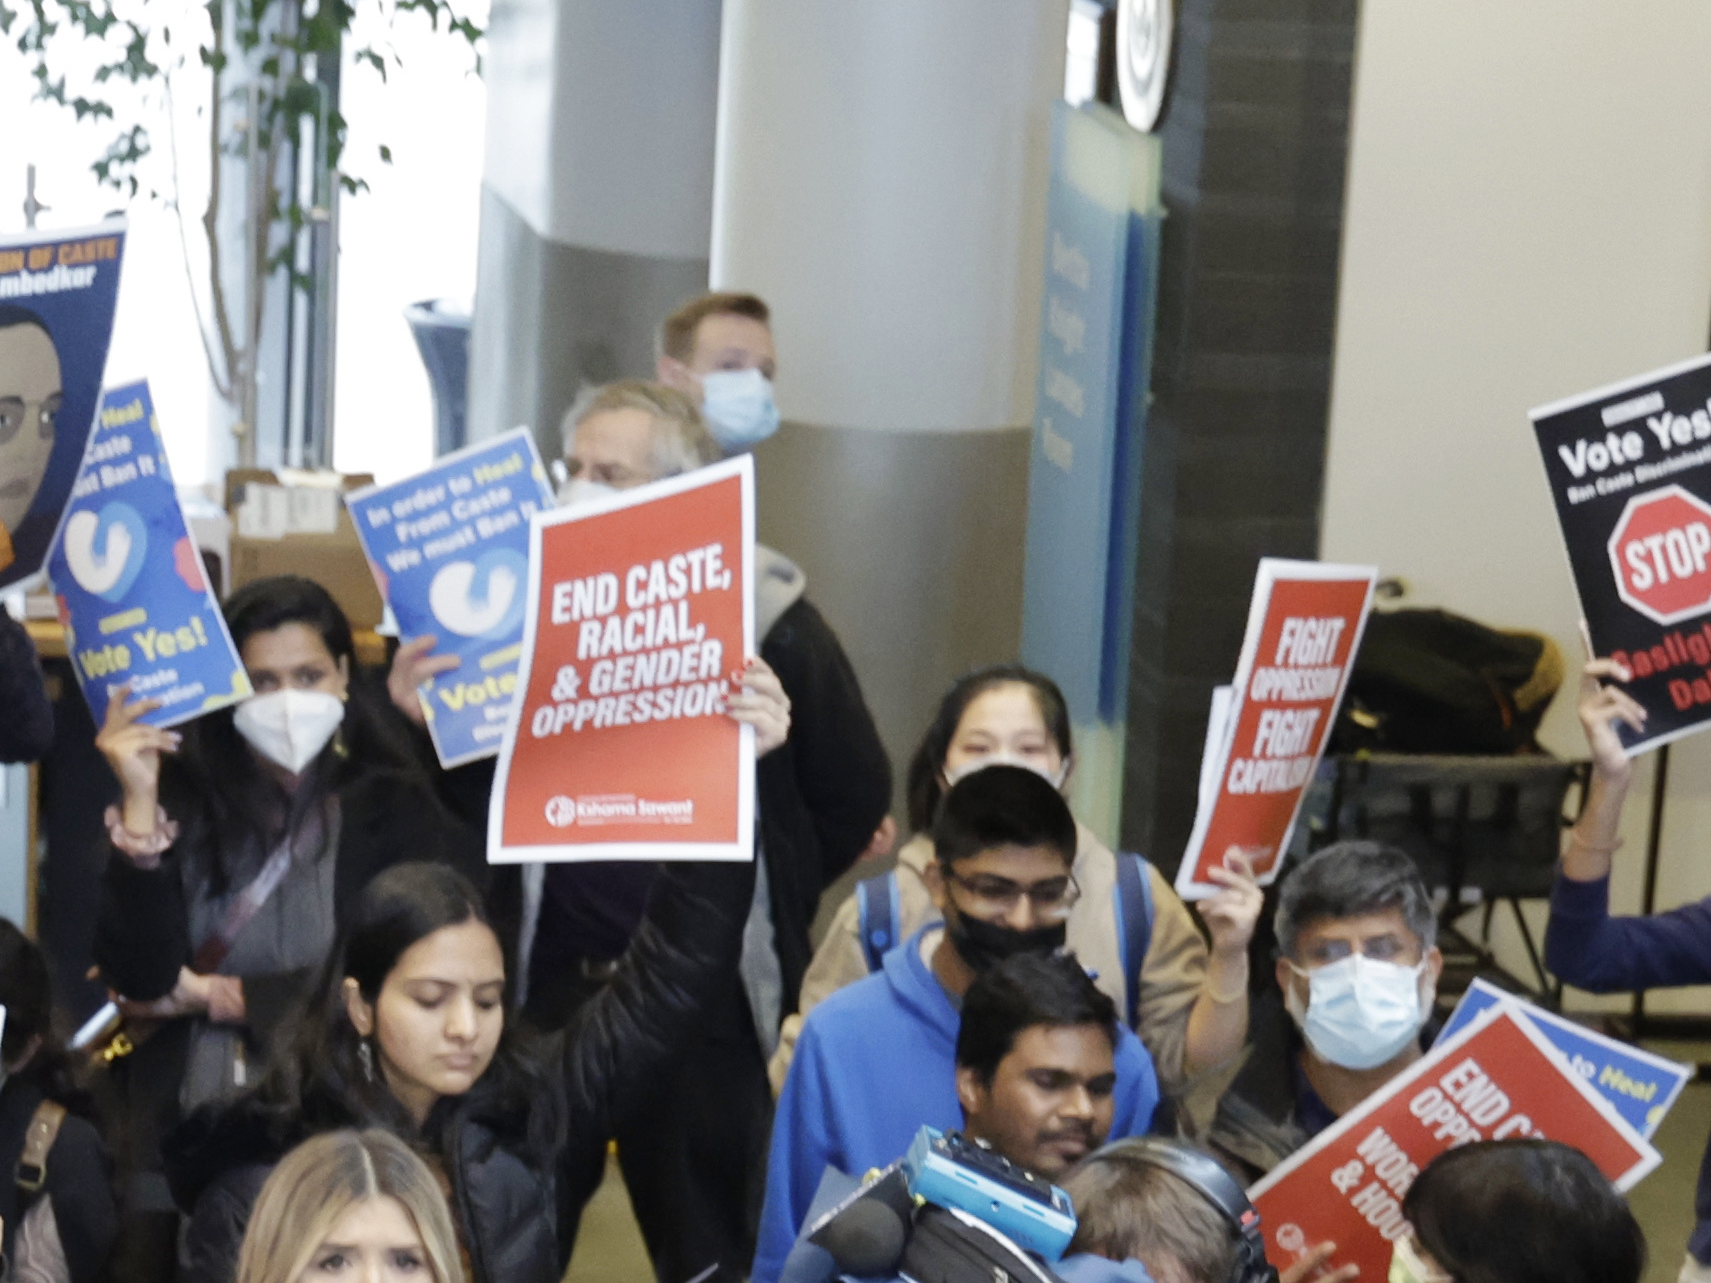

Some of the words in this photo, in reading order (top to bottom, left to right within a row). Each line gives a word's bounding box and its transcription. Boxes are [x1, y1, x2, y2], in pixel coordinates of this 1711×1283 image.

[1558, 431, 1644, 478] Vote
[1625, 521, 1711, 590] STOP
[551, 572, 619, 625] END
[625, 542, 732, 610] CASTE,
[133, 615, 208, 663] Yes!
[577, 600, 706, 661] RACIAL,
[1275, 617, 1347, 666] FIGHT
[439, 672, 518, 711] Vote
[551, 664, 581, 702] &
[589, 639, 722, 696] GENDER
[531, 679, 729, 739] OPPRESSION
[1253, 708, 1322, 757] FIGHT
[1439, 1057, 1510, 1126] END
[1331, 1160, 1366, 1194] &
